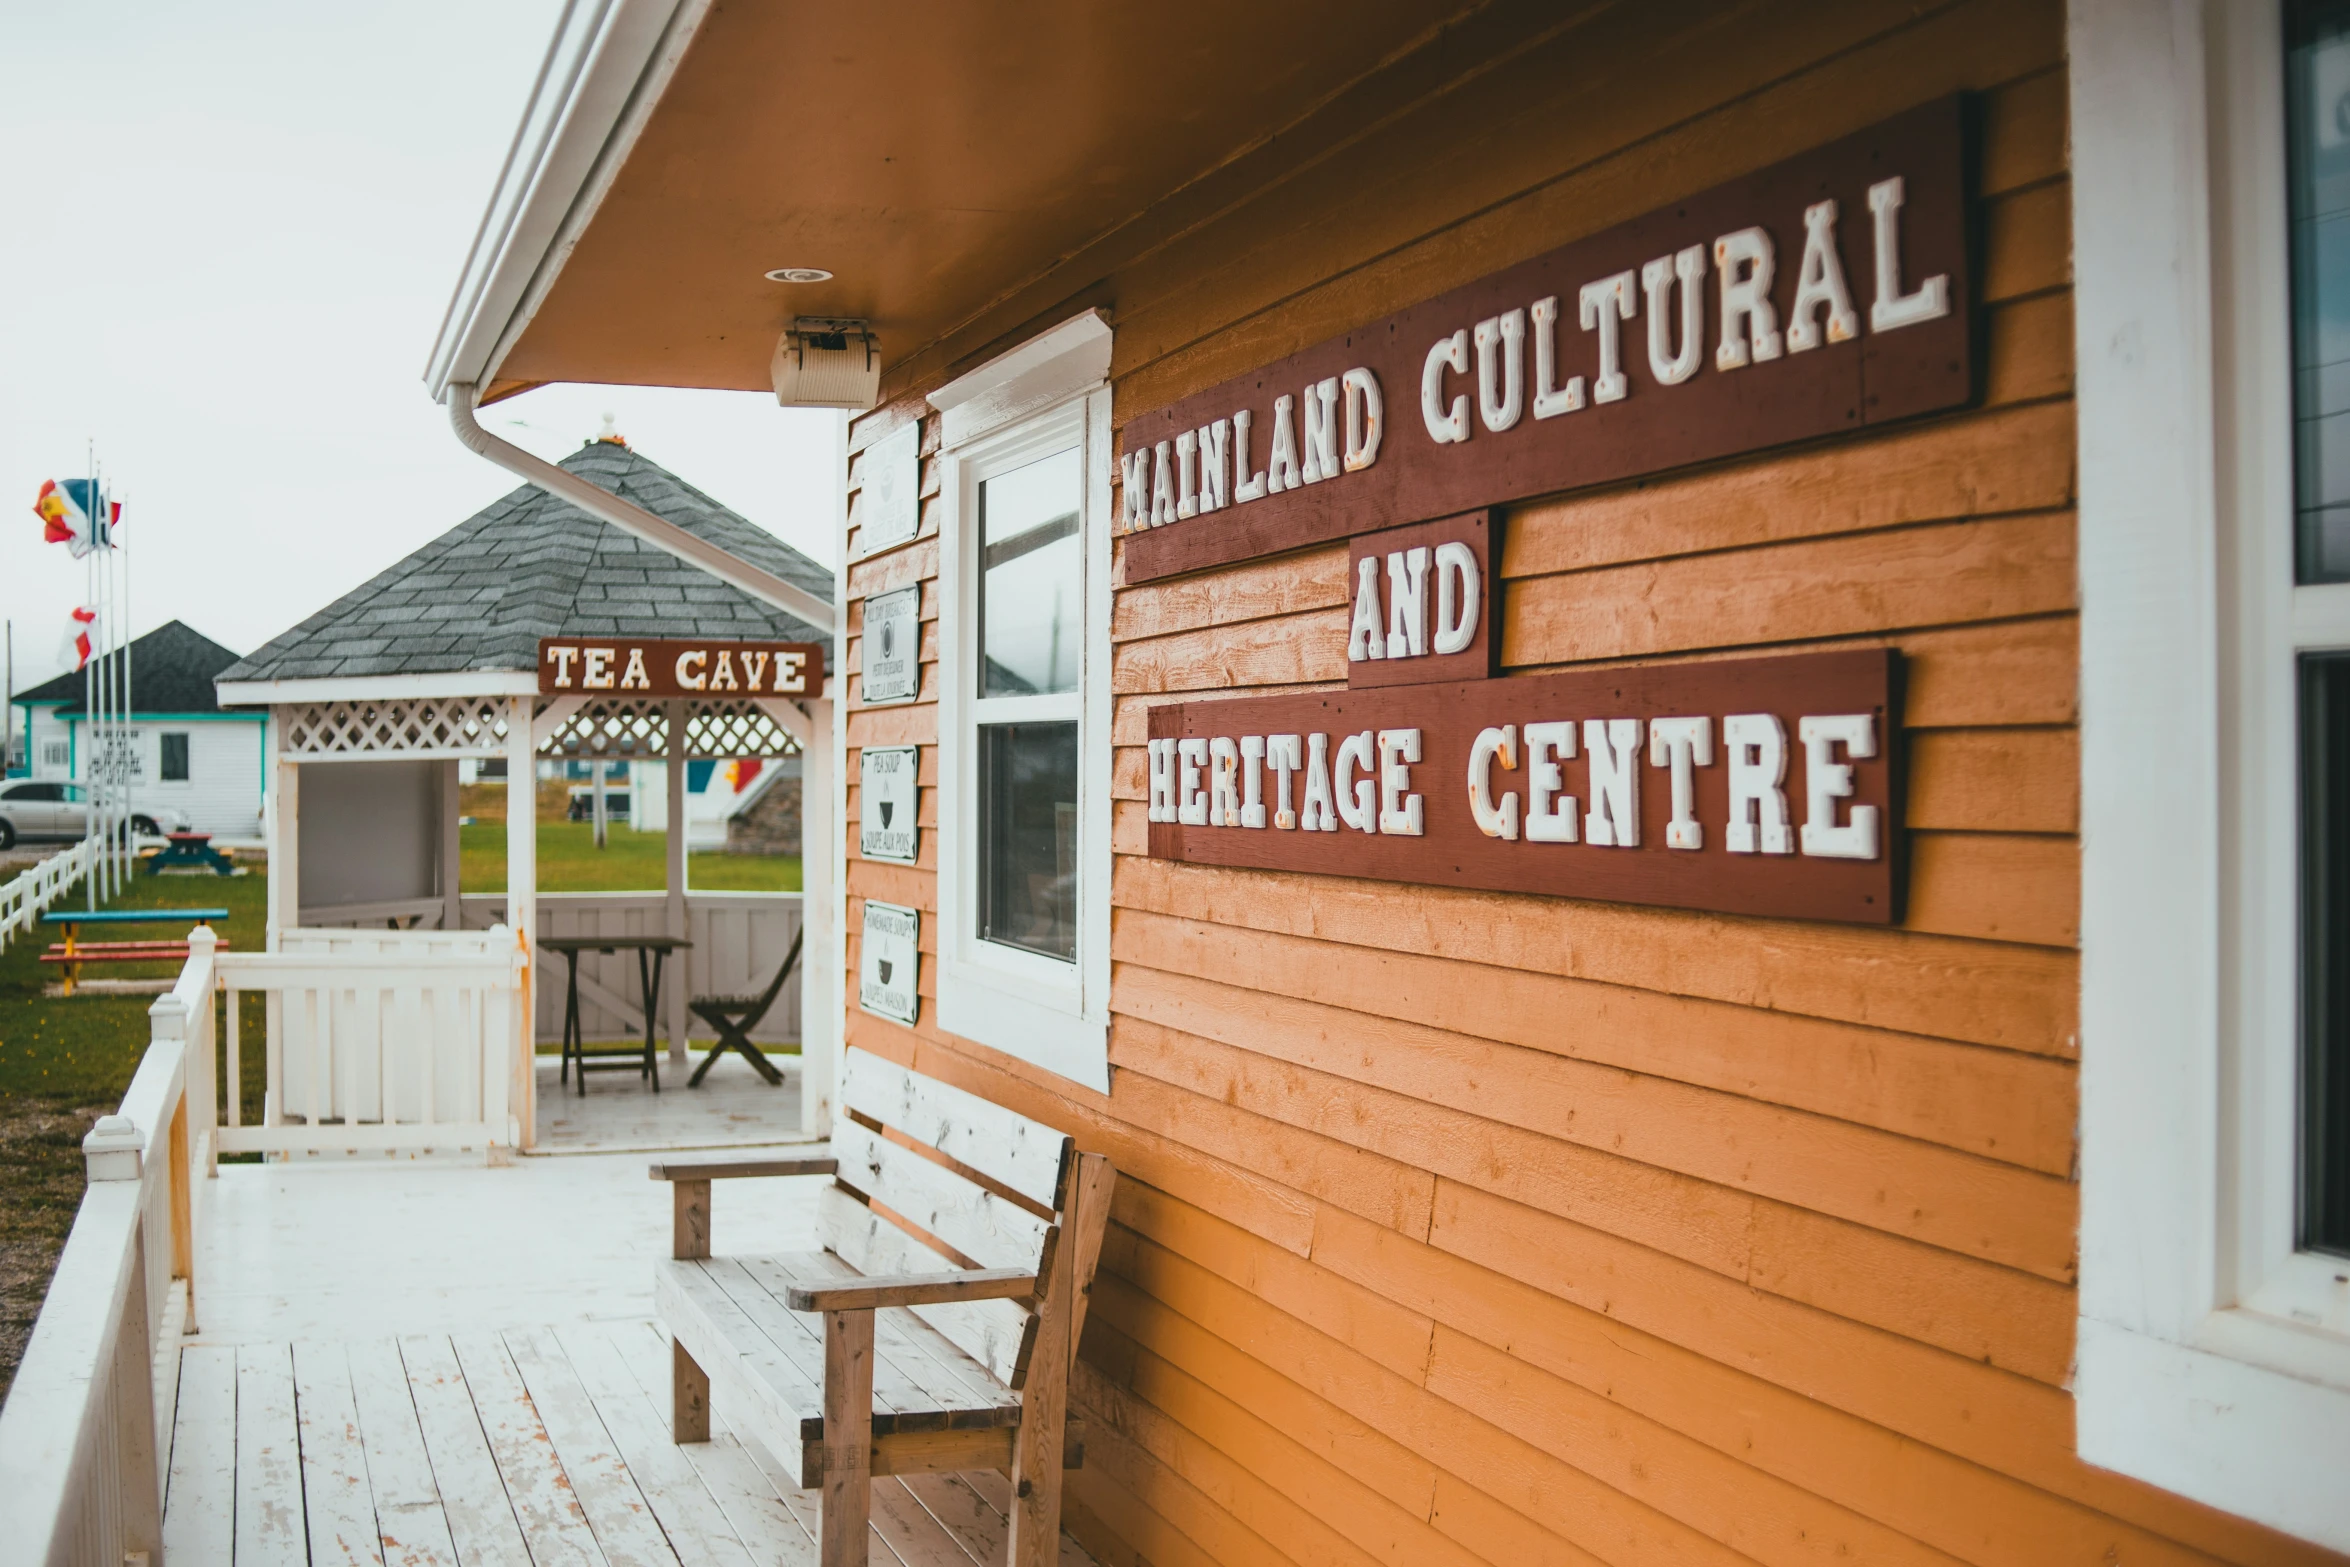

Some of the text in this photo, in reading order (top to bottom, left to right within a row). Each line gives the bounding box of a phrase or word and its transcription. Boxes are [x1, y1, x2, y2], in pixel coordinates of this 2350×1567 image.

[1121, 176, 1952, 534] MAINLAND CULTURAL
[1347, 541, 1482, 663] AND
[547, 646, 807, 693] TEA CAVE
[873, 753, 900, 774] PEA SOUP
[1147, 713, 1882, 862] HERITAGE CENTRE
